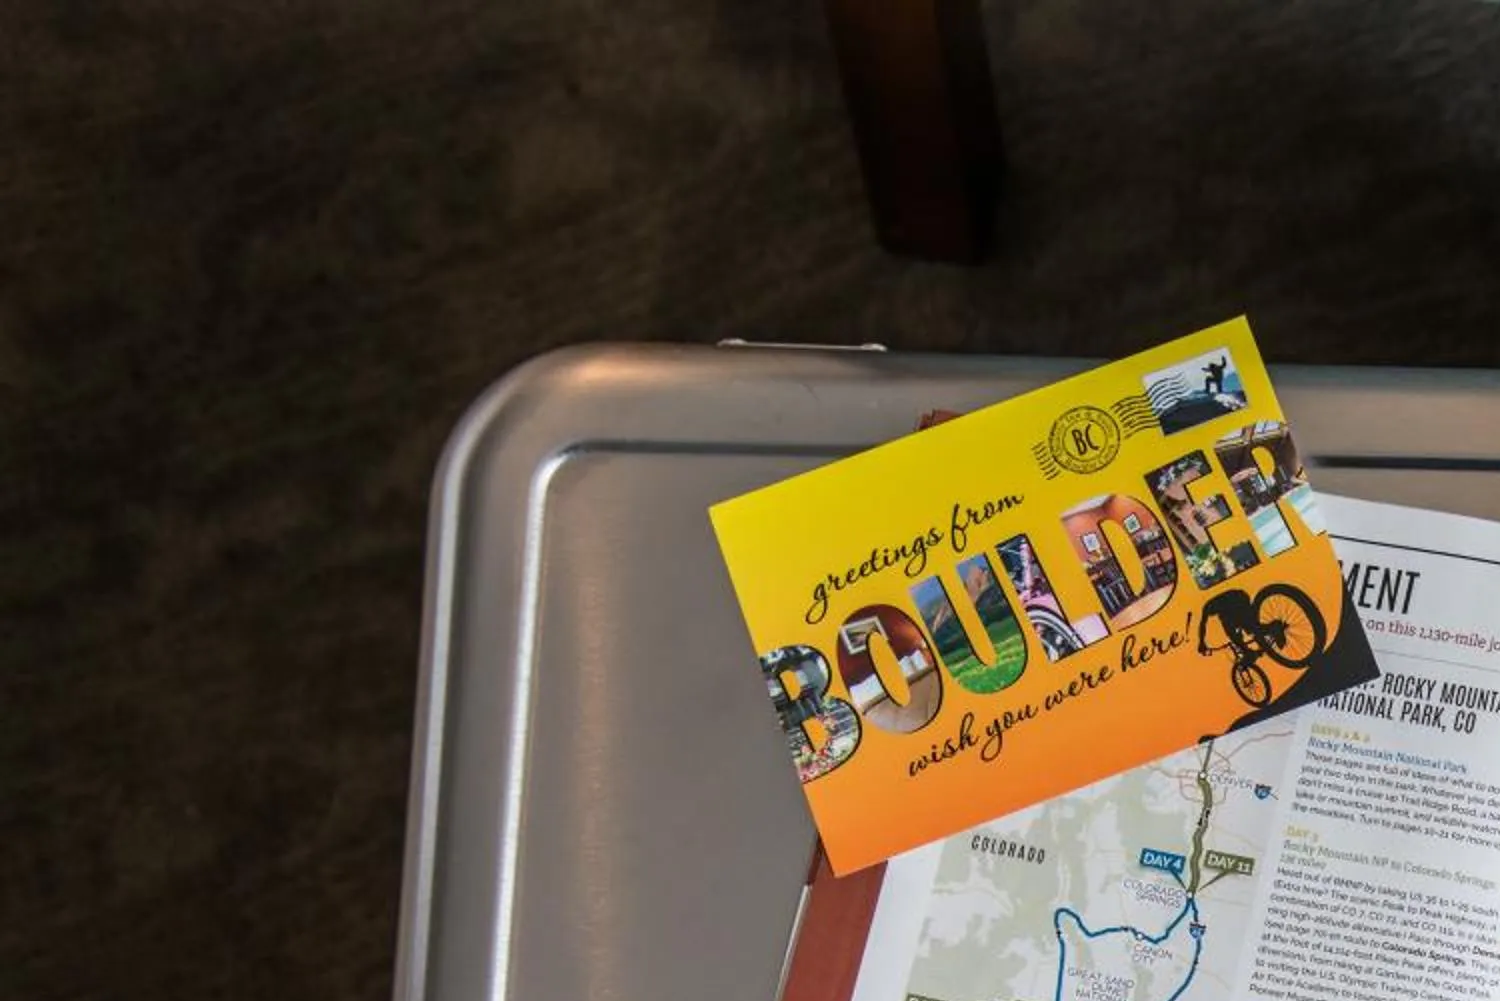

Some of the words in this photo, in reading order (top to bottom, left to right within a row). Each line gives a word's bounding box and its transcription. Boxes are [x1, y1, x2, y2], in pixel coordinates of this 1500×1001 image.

[1072, 424, 1099, 455] BC
[805, 528, 944, 625] greetings
[949, 491, 1024, 553] from
[759, 419, 1327, 784] BOULDER
[1340, 561, 1421, 615] MENT
[1365, 617, 1384, 632] on
[1387, 618, 1417, 638] this
[1418, 622, 1487, 652] 1,130-mile
[907, 712, 975, 778] wish
[978, 704, 1039, 762] you
[1044, 665, 1115, 713] were
[1119, 612, 1195, 678] here!
[1381, 669, 1436, 702] ROCKY
[1317, 692, 1395, 721] NATIONAL
[1398, 698, 1450, 733] PARK,
[1452, 708, 1477, 735] CO
[1341, 740, 1394, 762] Mountain
[1396, 750, 1441, 770] National
[1443, 760, 1468, 775] Park
[971, 835, 1045, 864] COLORADO
[1143, 853, 1171, 867] DAY
[1172, 859, 1181, 869] 4
[1207, 854, 1235, 869] DAY
[1237, 861, 1251, 873] 11
[1380, 940, 1426, 958] Colorado
